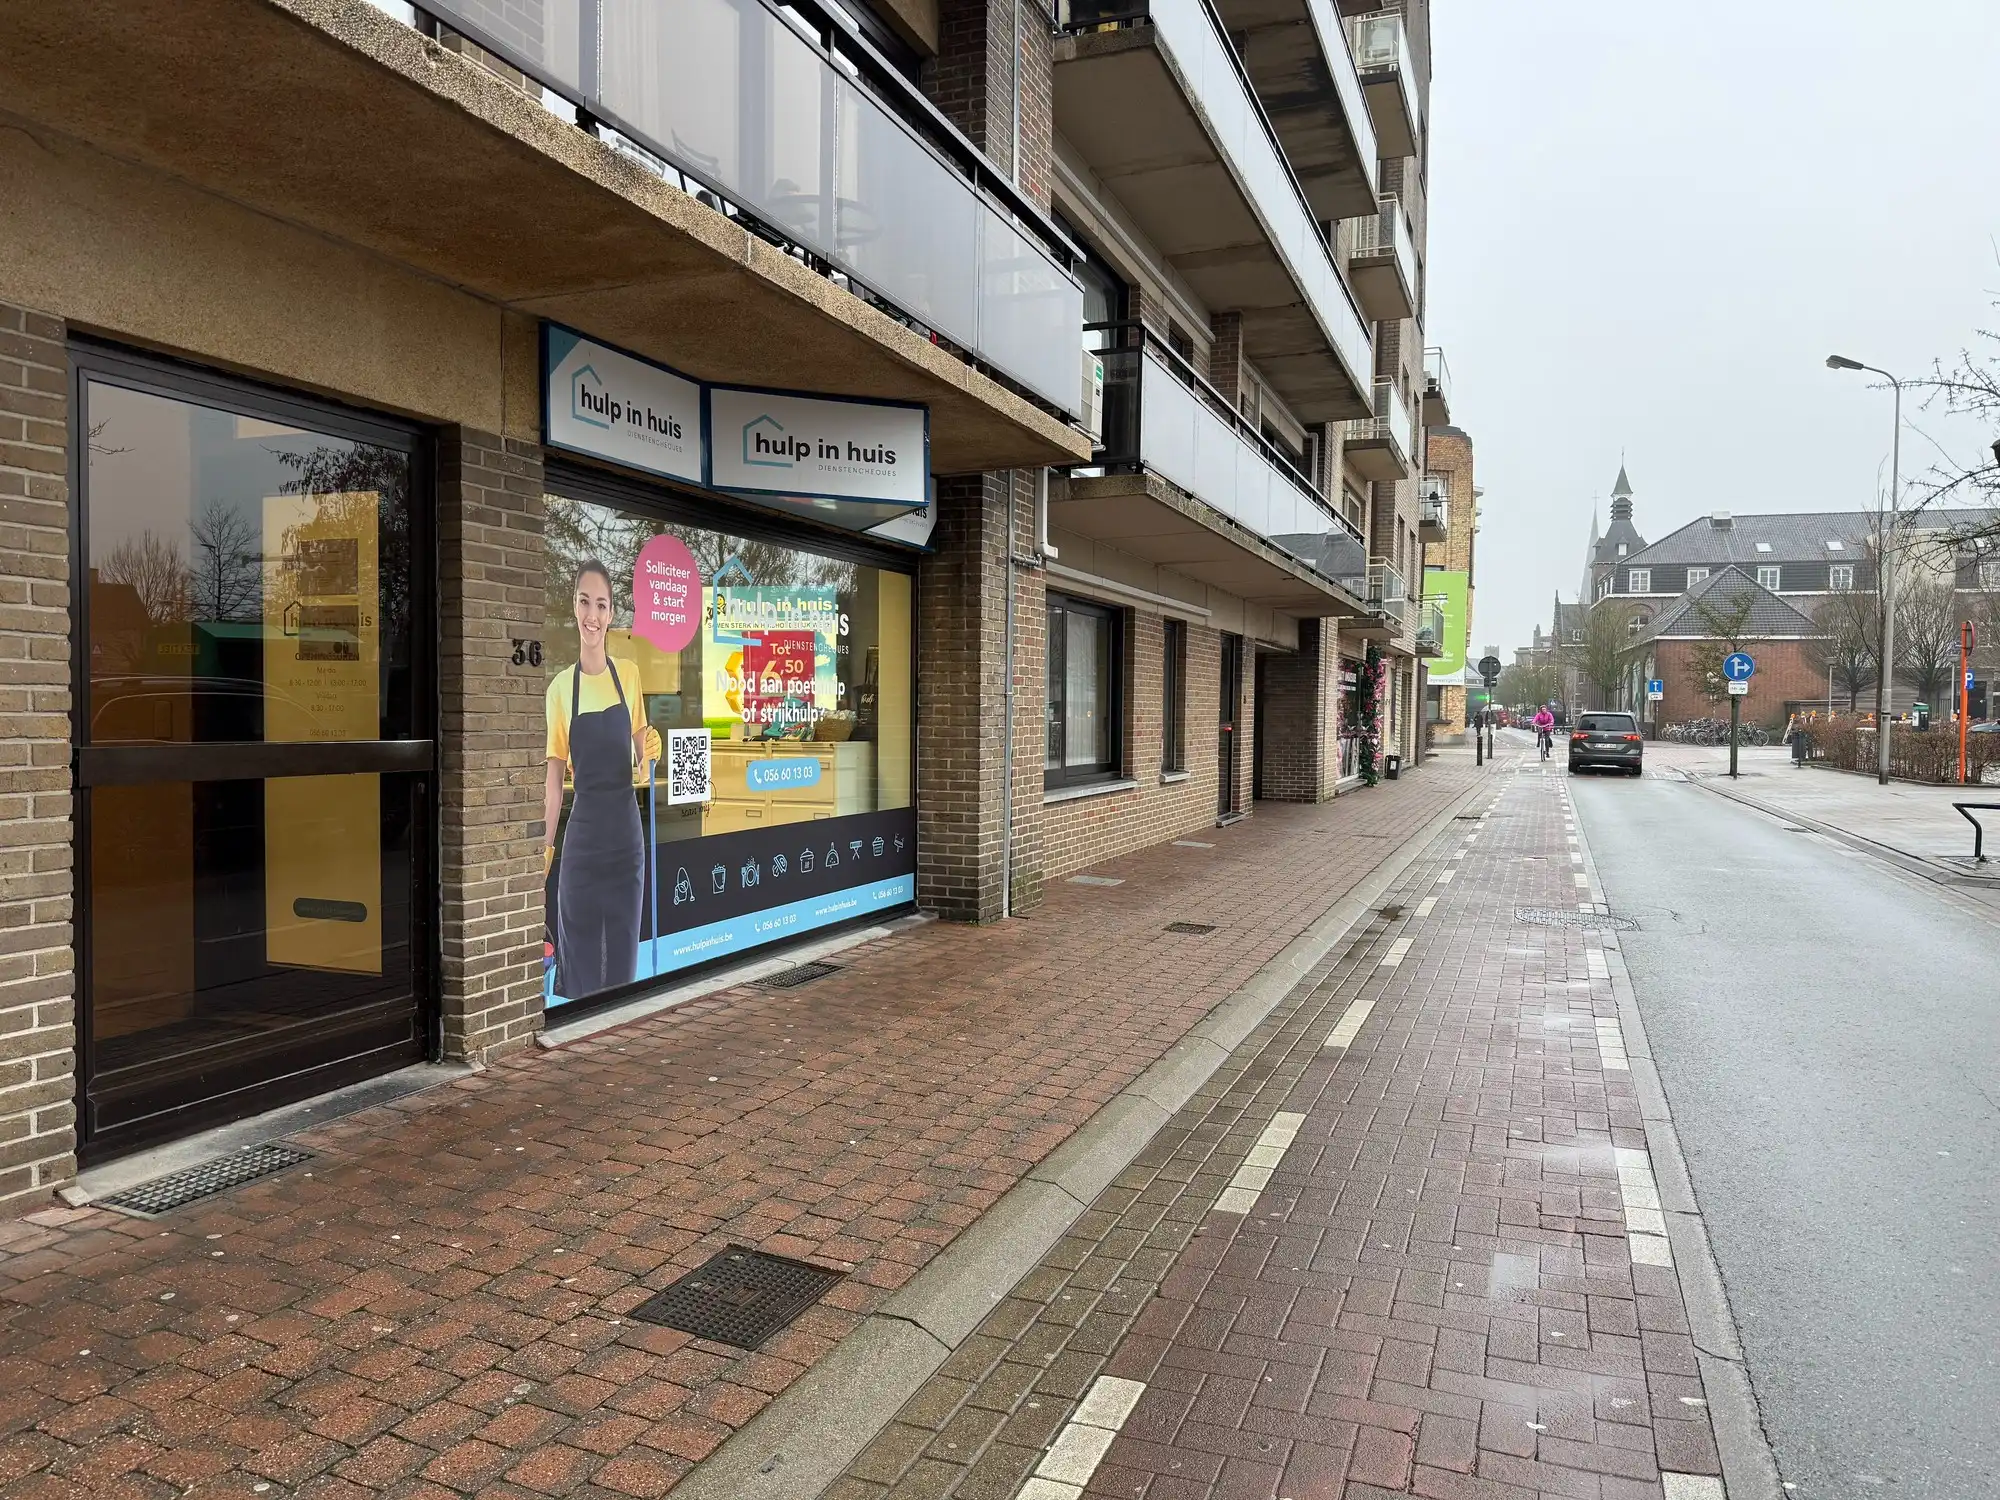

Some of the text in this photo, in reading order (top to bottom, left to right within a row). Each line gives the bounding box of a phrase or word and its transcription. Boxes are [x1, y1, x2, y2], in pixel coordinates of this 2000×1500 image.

[581, 384, 682, 440] hulp in huis
[627, 430, 683, 453] DIENSTENCHEQUES
[756, 433, 896, 465] hulp in huis
[818, 464, 897, 477] DIENSTENCHEQUES
[646, 560, 691, 579] Solliciteer
[649, 579, 688, 597] vandaag
[653, 592, 684, 608] & start
[651, 611, 686, 625] morgen
[511, 640, 542, 667] 36
[770, 643, 790, 655] Tot
[716, 671, 756, 692] Nood
[760, 679, 783, 694] aan
[1965, 673, 1973, 688] P
[743, 701, 825, 728] of strijkhulp?
[764, 766, 813, 782] 056 60 13 03
[762, 914, 797, 930] 056 60 13 03
[673, 932, 733, 956] www.hulpinhuis.be
